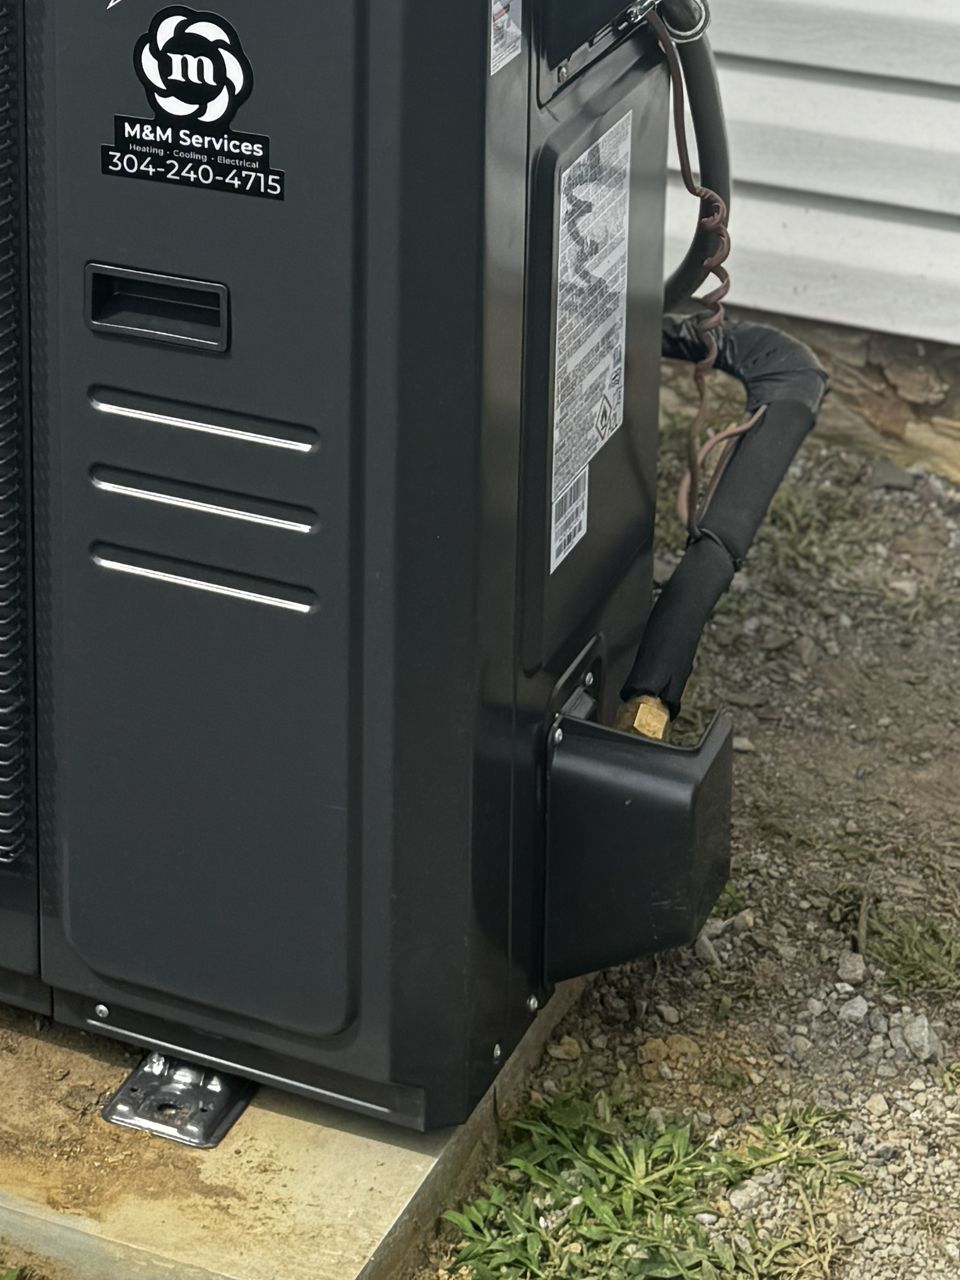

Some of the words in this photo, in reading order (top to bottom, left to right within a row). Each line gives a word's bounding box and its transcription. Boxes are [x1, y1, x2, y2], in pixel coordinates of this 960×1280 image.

[166, 52, 217, 86] m
[124, 121, 173, 144] M&M
[178, 129, 264, 157] Services
[128, 143, 164, 157] Heating
[172, 149, 208, 163] Cooling
[217, 155, 260, 169] Electrical
[107, 150, 282, 195] 304-240-4715
